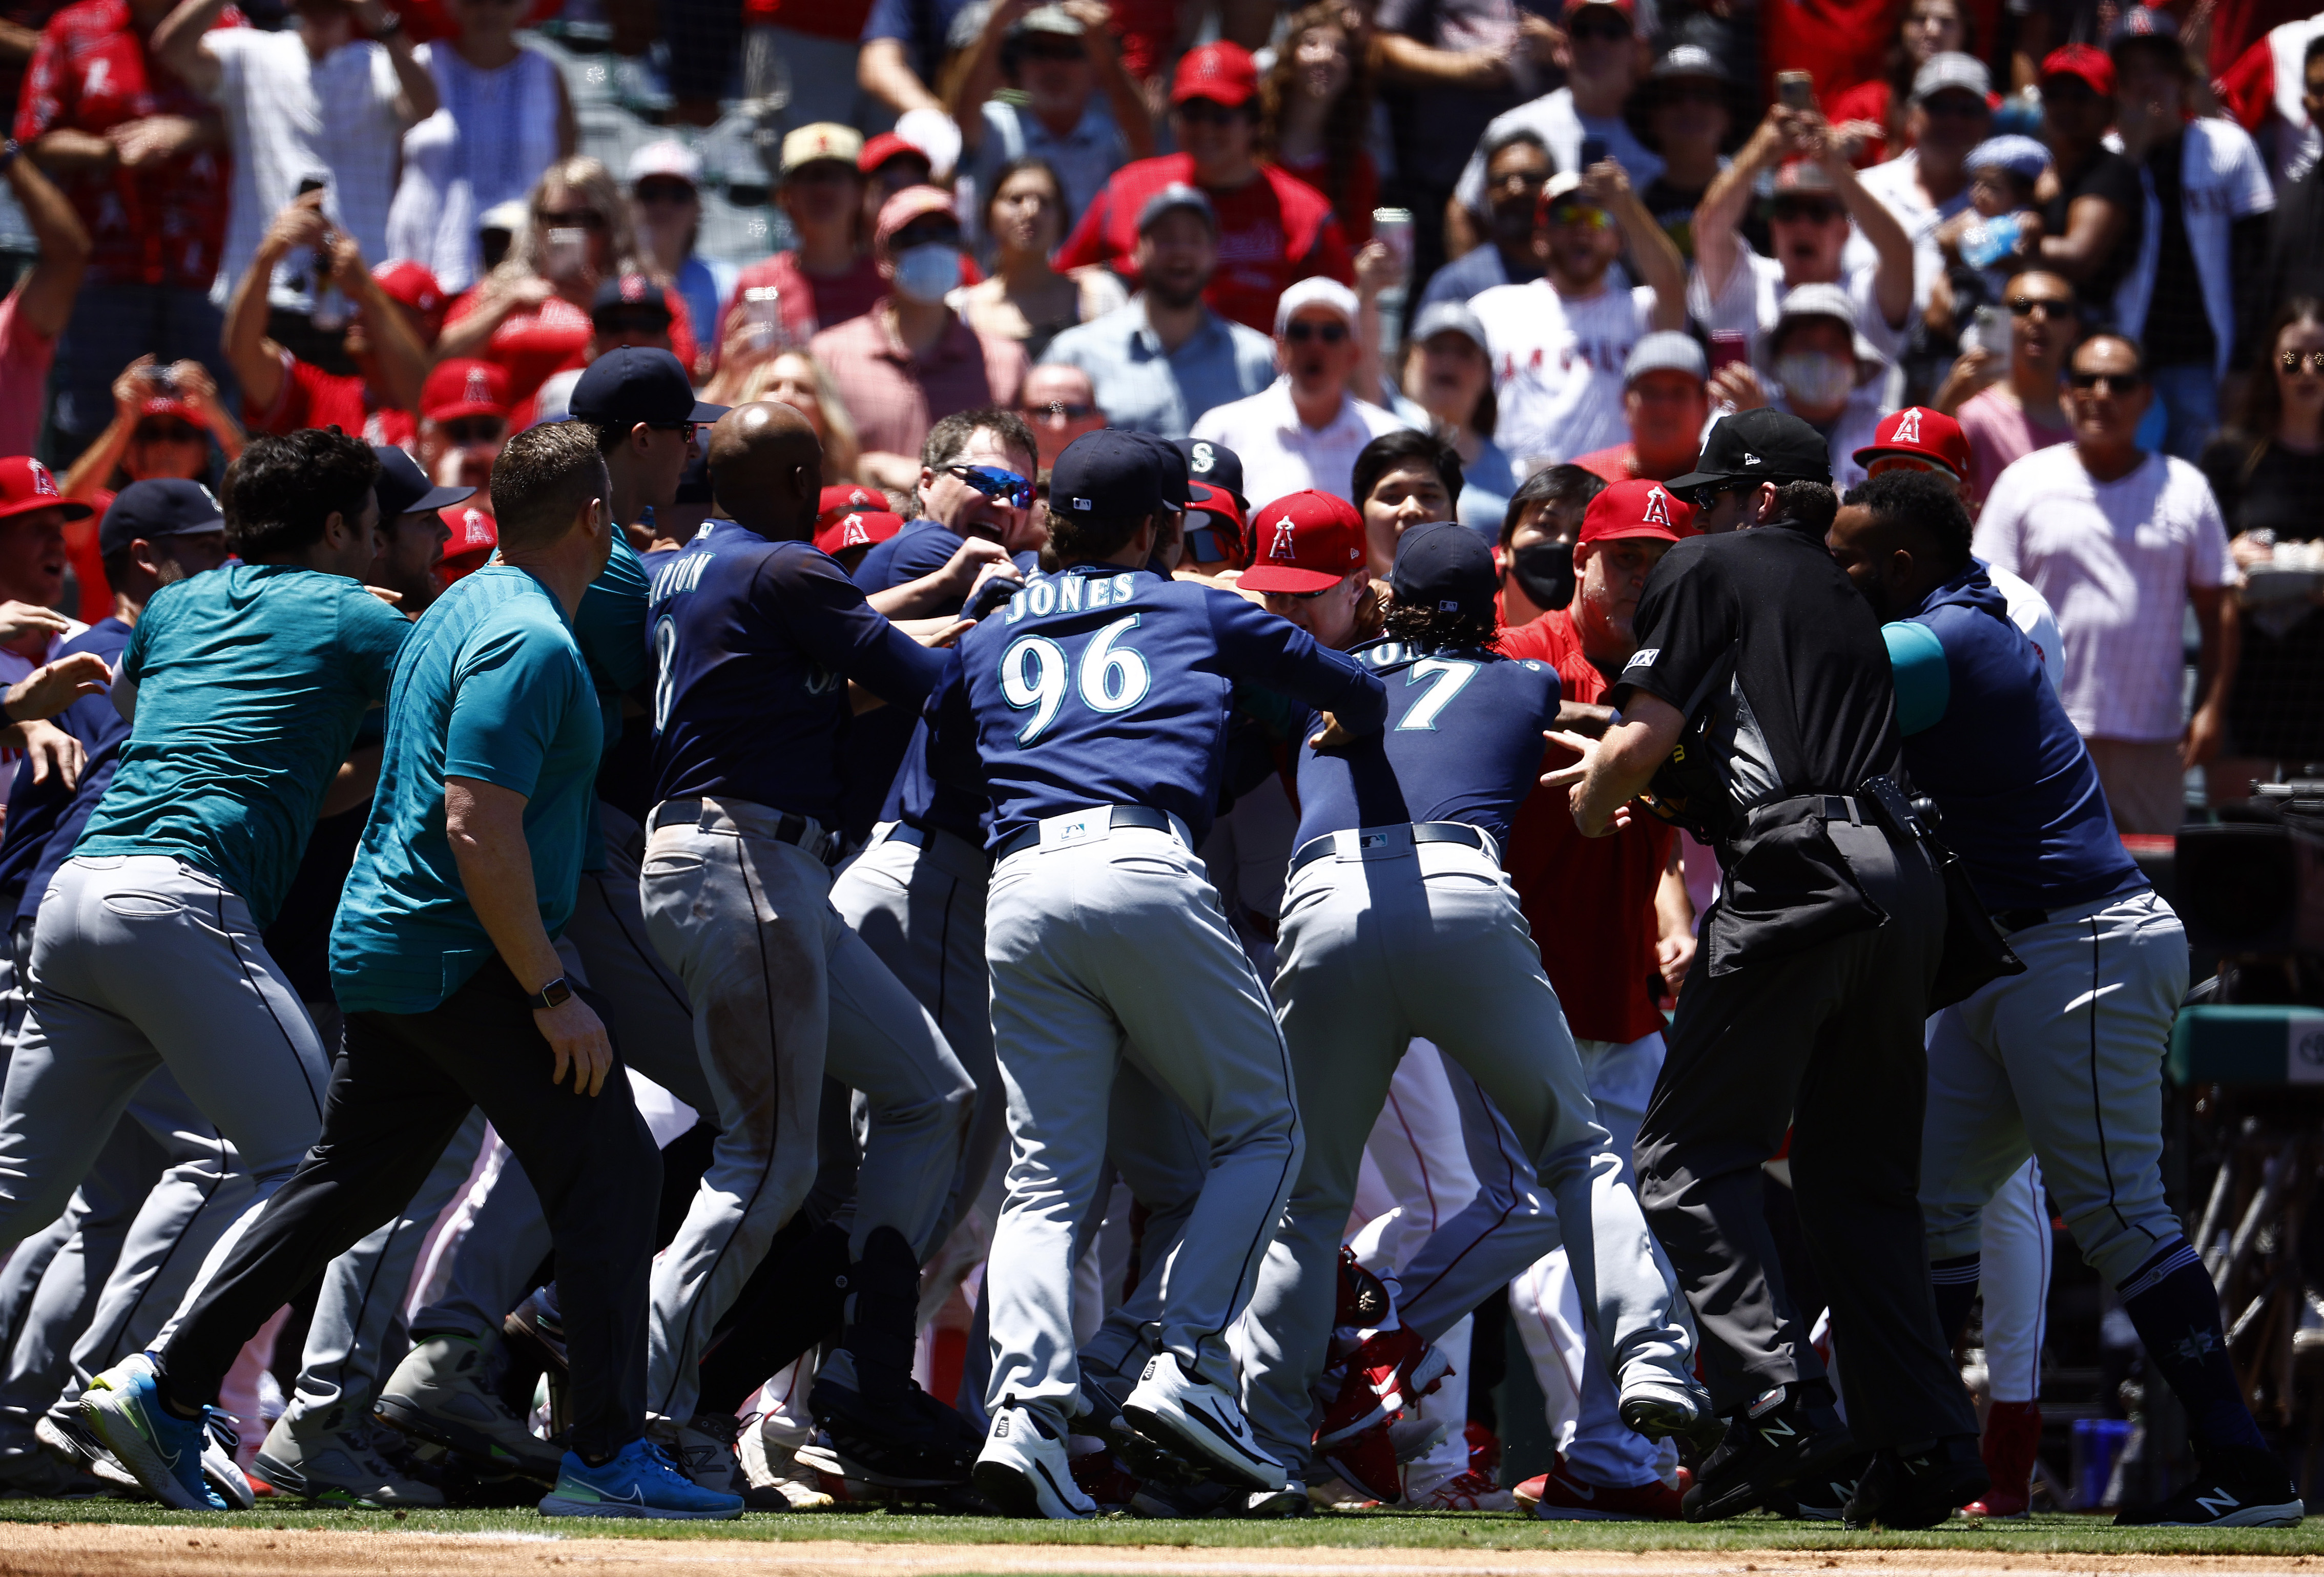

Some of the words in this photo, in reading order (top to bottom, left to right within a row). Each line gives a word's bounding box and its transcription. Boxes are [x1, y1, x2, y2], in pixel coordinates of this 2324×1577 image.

[1892, 407, 1922, 443] A
[1192, 443, 1216, 472] S
[1643, 486, 1671, 526] A
[463, 507, 493, 544] A
[843, 513, 870, 547] A
[1270, 515, 1295, 558] A
[1005, 573, 1134, 625] JONES
[998, 613, 1151, 749] 96
[1394, 657, 1481, 732] 7
[1144, 1363, 1156, 1379] AIR
[997, 1420, 1009, 1436] AIR
[1759, 1416, 1796, 1448] N
[2195, 1486, 2240, 1518] N
